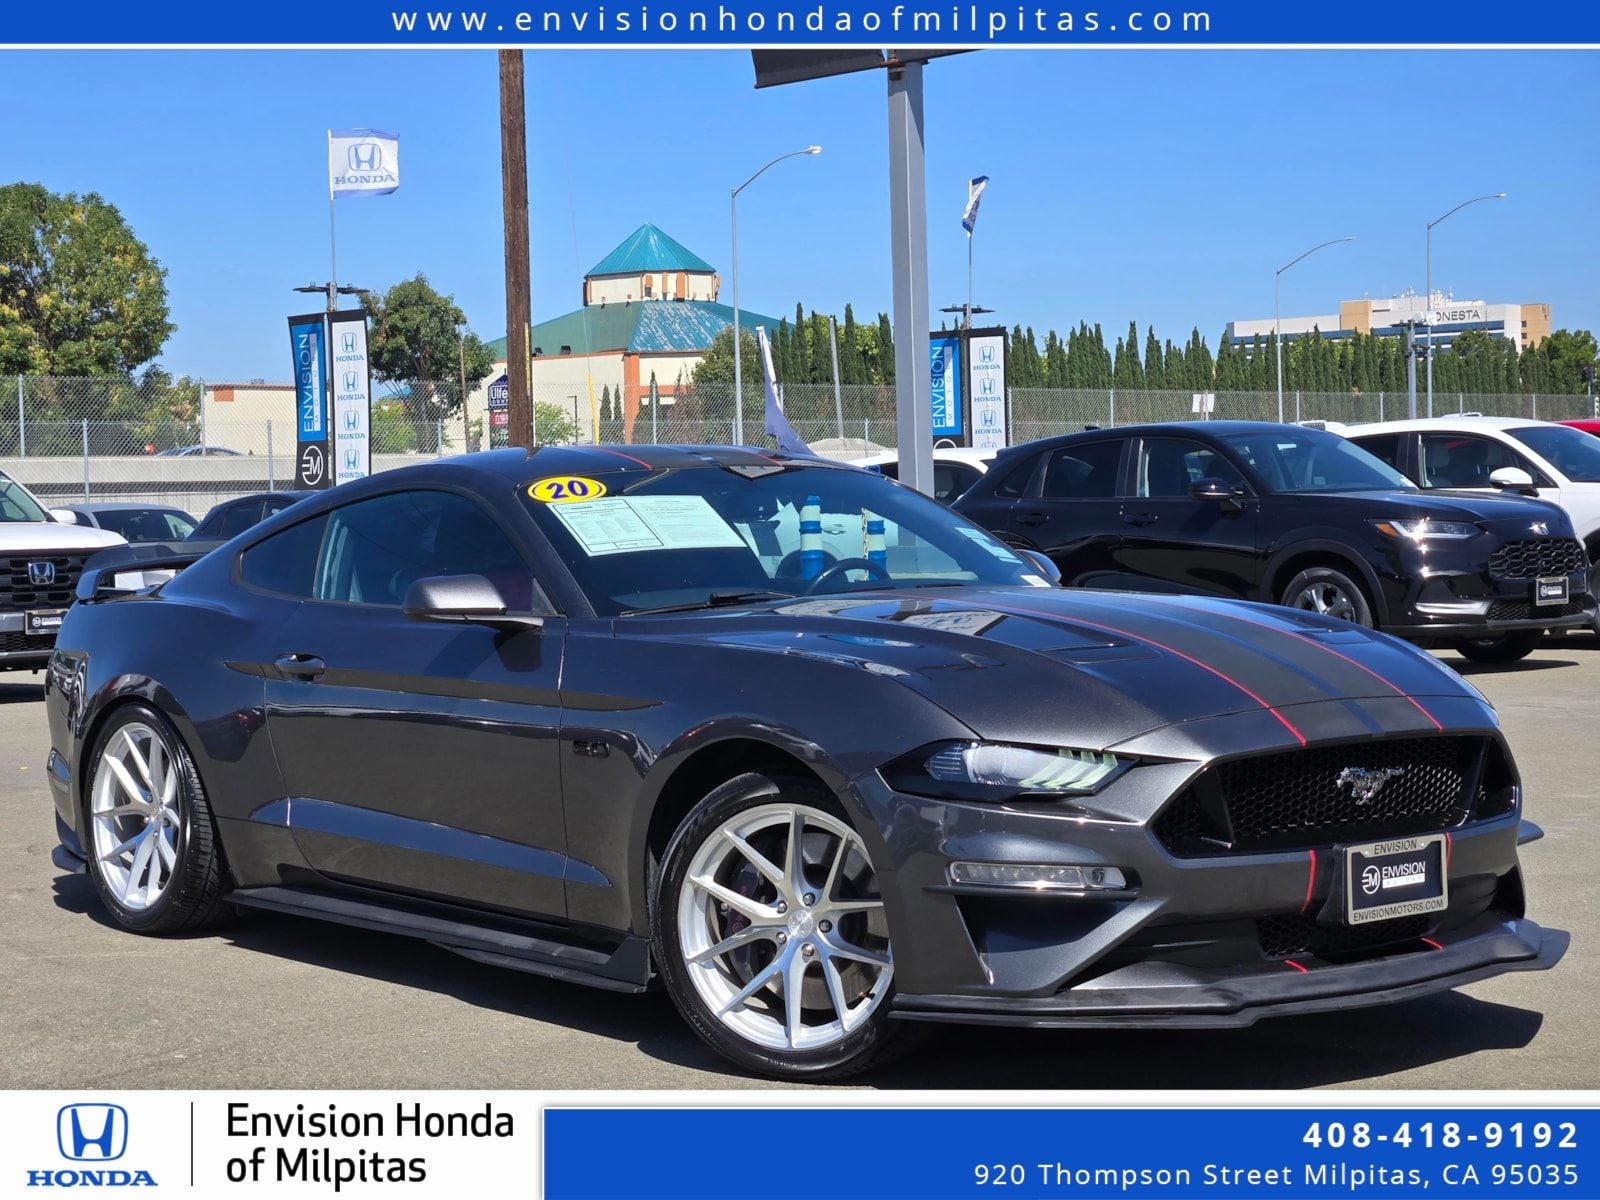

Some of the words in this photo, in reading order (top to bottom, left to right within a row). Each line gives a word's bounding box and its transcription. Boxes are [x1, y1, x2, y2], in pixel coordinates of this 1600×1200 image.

[334, 174, 396, 185] HONDA
[1435, 309, 1481, 321] ONESTA
[336, 354, 365, 362] HONDA
[298, 334, 314, 432] ENVISION
[931, 346, 945, 428] ENVISION
[337, 393, 366, 401] HONDA
[338, 432, 366, 440] HONDA
[546, 480, 589, 500] 20
[1374, 839, 1418, 855] ENVISION
[1382, 861, 1426, 878] ENVISION
[1353, 899, 1443, 922] ENVISIONMOTORS.COM
